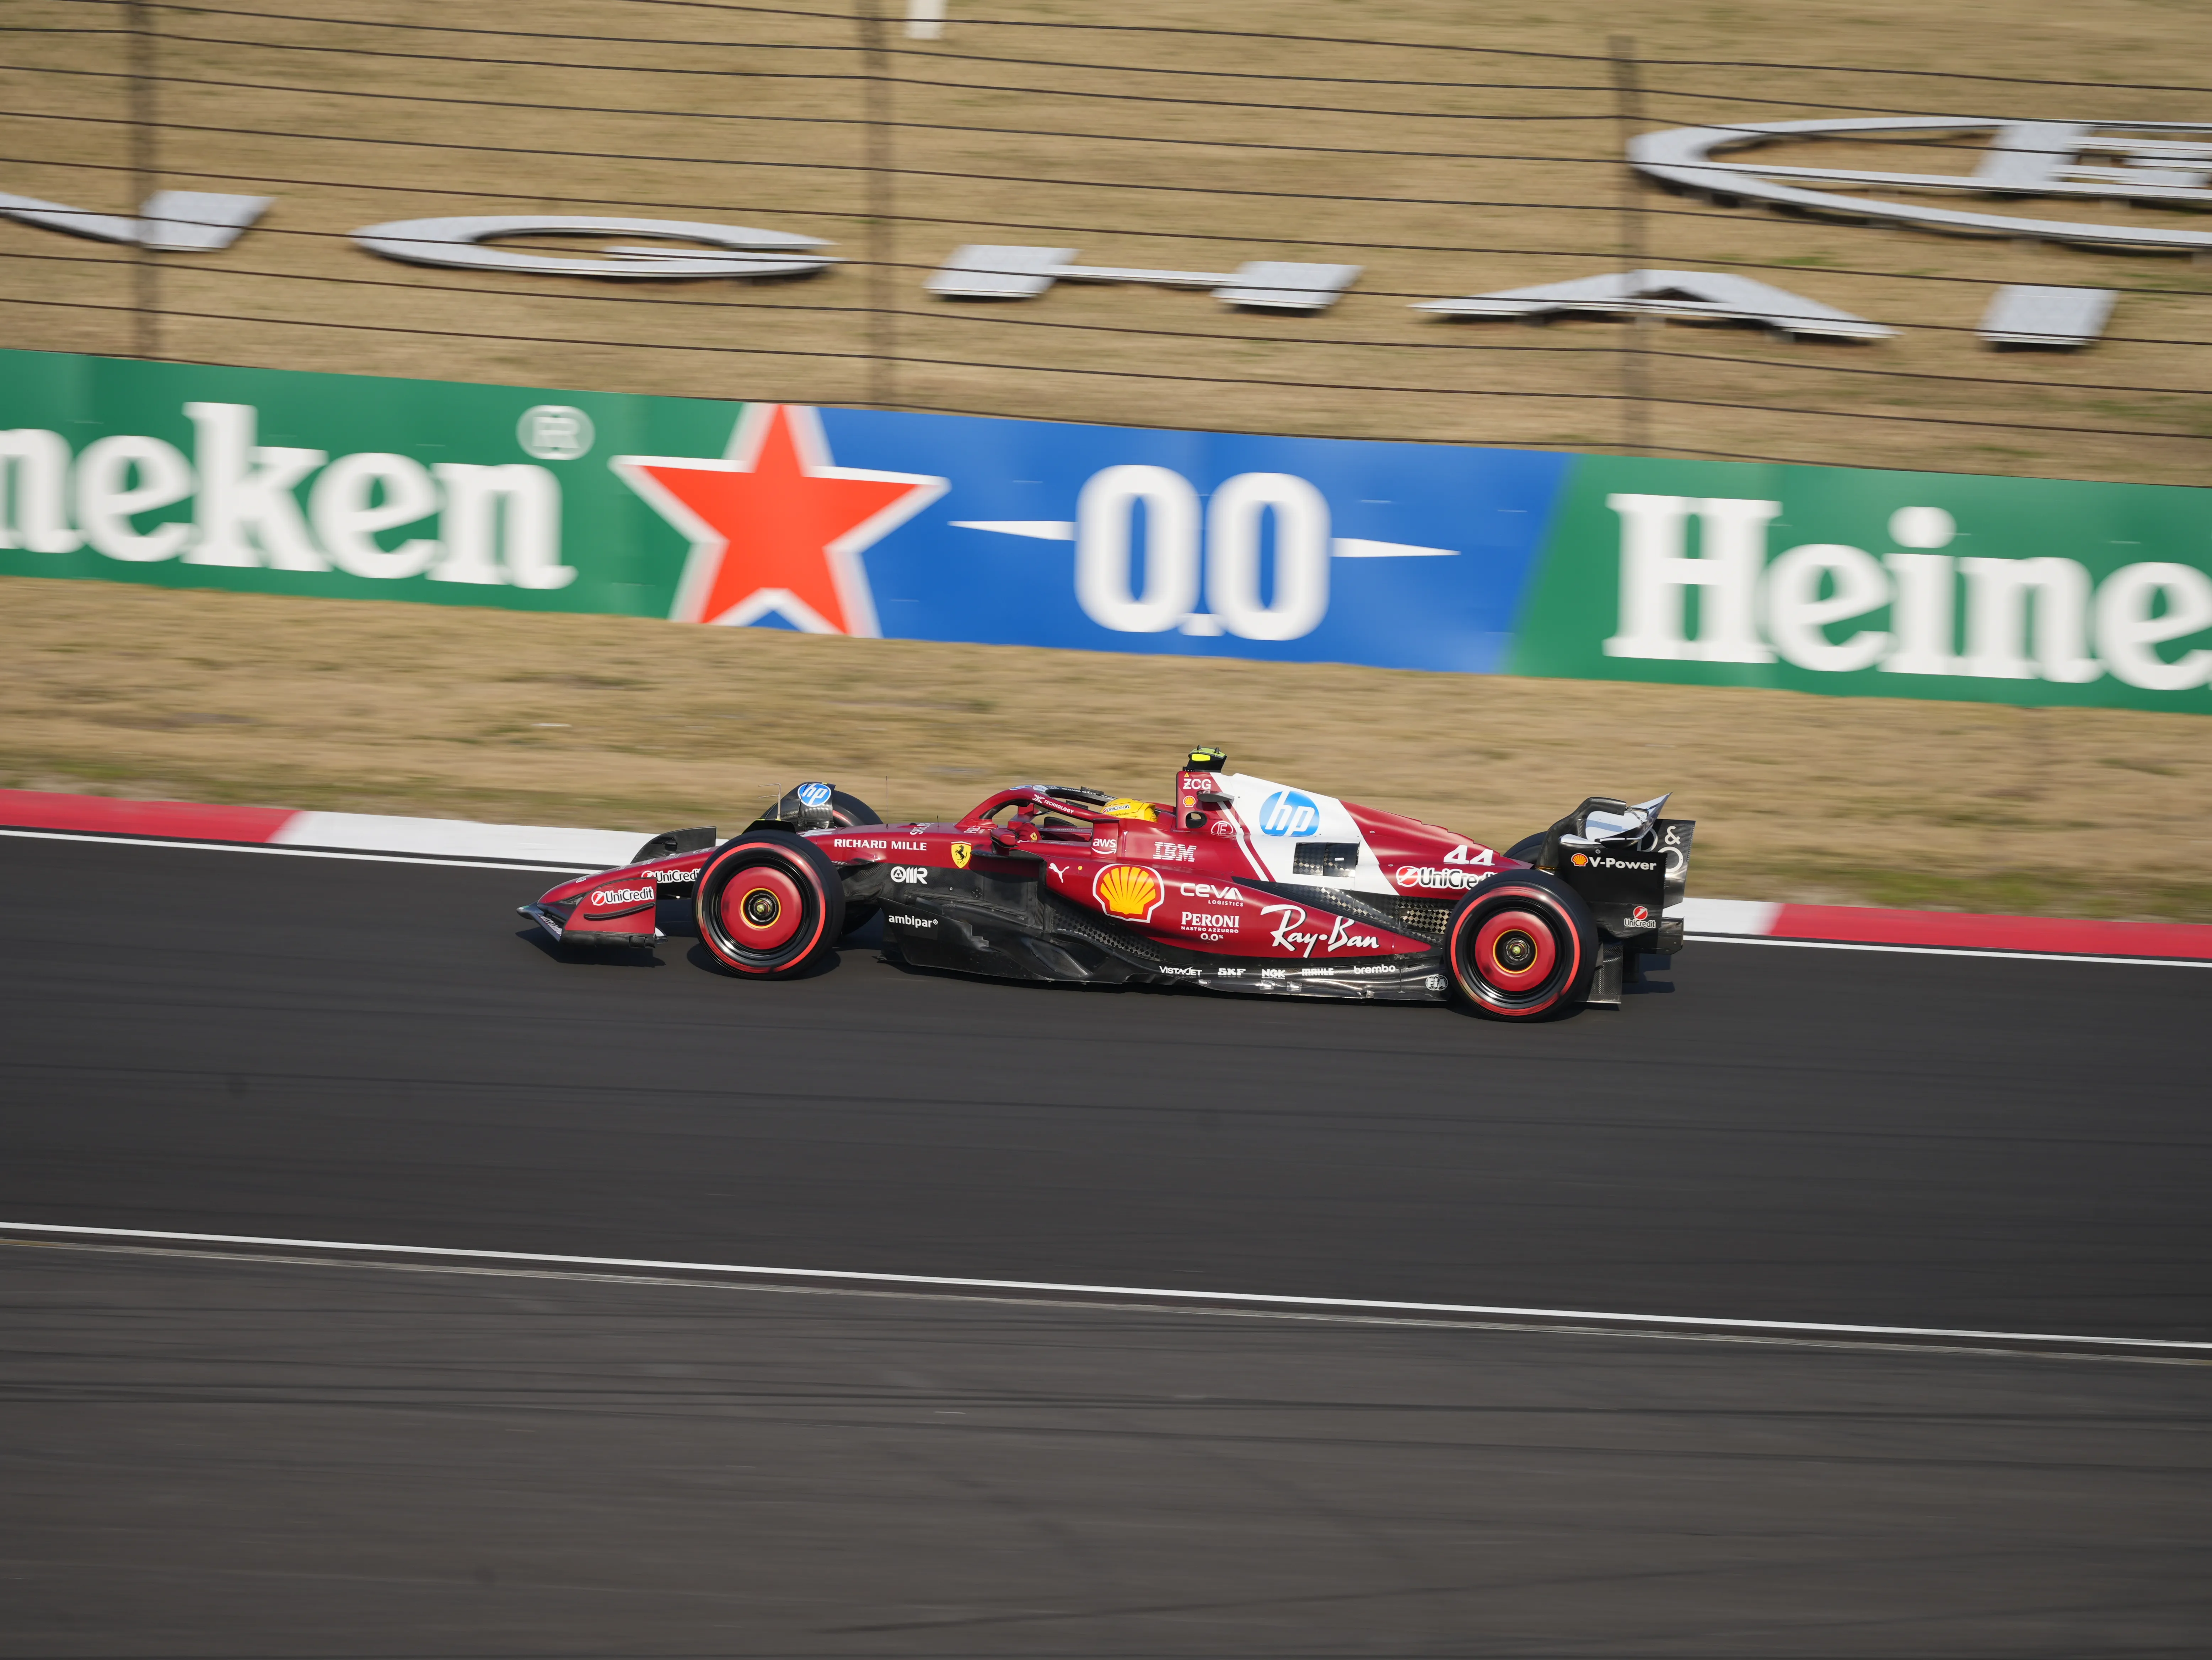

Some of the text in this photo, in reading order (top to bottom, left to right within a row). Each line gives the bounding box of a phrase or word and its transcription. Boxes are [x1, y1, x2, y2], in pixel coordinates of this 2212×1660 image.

[1074, 464, 1332, 641] 0.0
[1602, 493, 2212, 690] Heine
[802, 783, 828, 806] hp
[1044, 799, 1074, 814] TECHNOLOGY
[1265, 791, 1315, 837] hp
[834, 839, 927, 851] RICHARD MILLE
[1093, 838, 1116, 848] aws
[1153, 841, 1197, 862] IBM
[1443, 845, 1495, 866] 44
[1589, 857, 1657, 870] V-Power
[656, 870, 699, 882] UniCredi
[1421, 868, 1493, 888] UniCre
[606, 887, 653, 902] UniCredit
[888, 915, 933, 928] ambipar
[1181, 911, 1240, 928] PERONI
[1625, 919, 1655, 928] UniCredit
[1201, 933, 1224, 941] 0.0%
[1262, 969, 1286, 977] NGK
[1354, 964, 1396, 975] brembo
